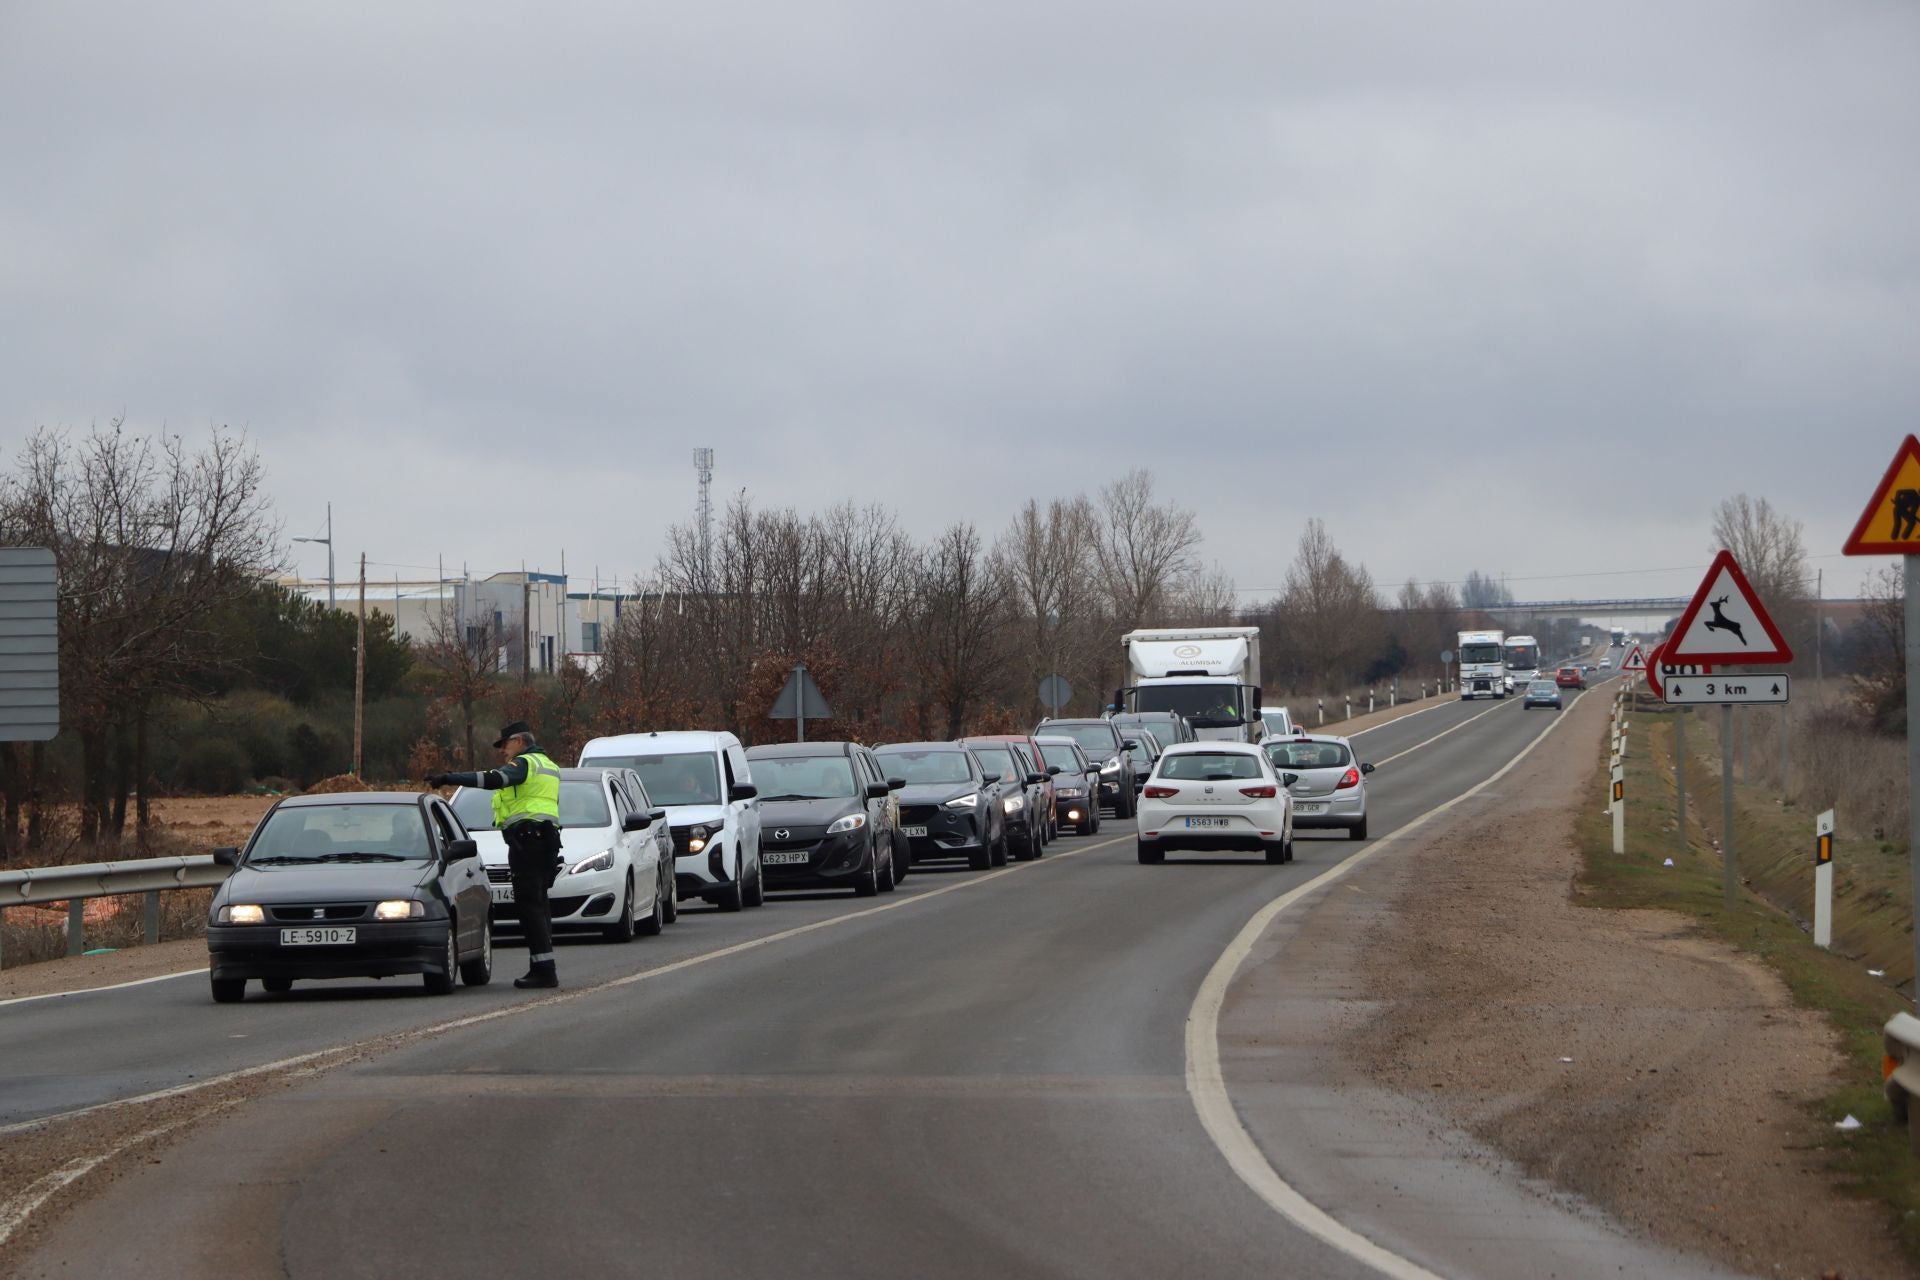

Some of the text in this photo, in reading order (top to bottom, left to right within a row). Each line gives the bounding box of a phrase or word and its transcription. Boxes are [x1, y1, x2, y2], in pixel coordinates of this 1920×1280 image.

[1706, 683, 1748, 695] 3 km
[788, 853, 807, 863] HPX
